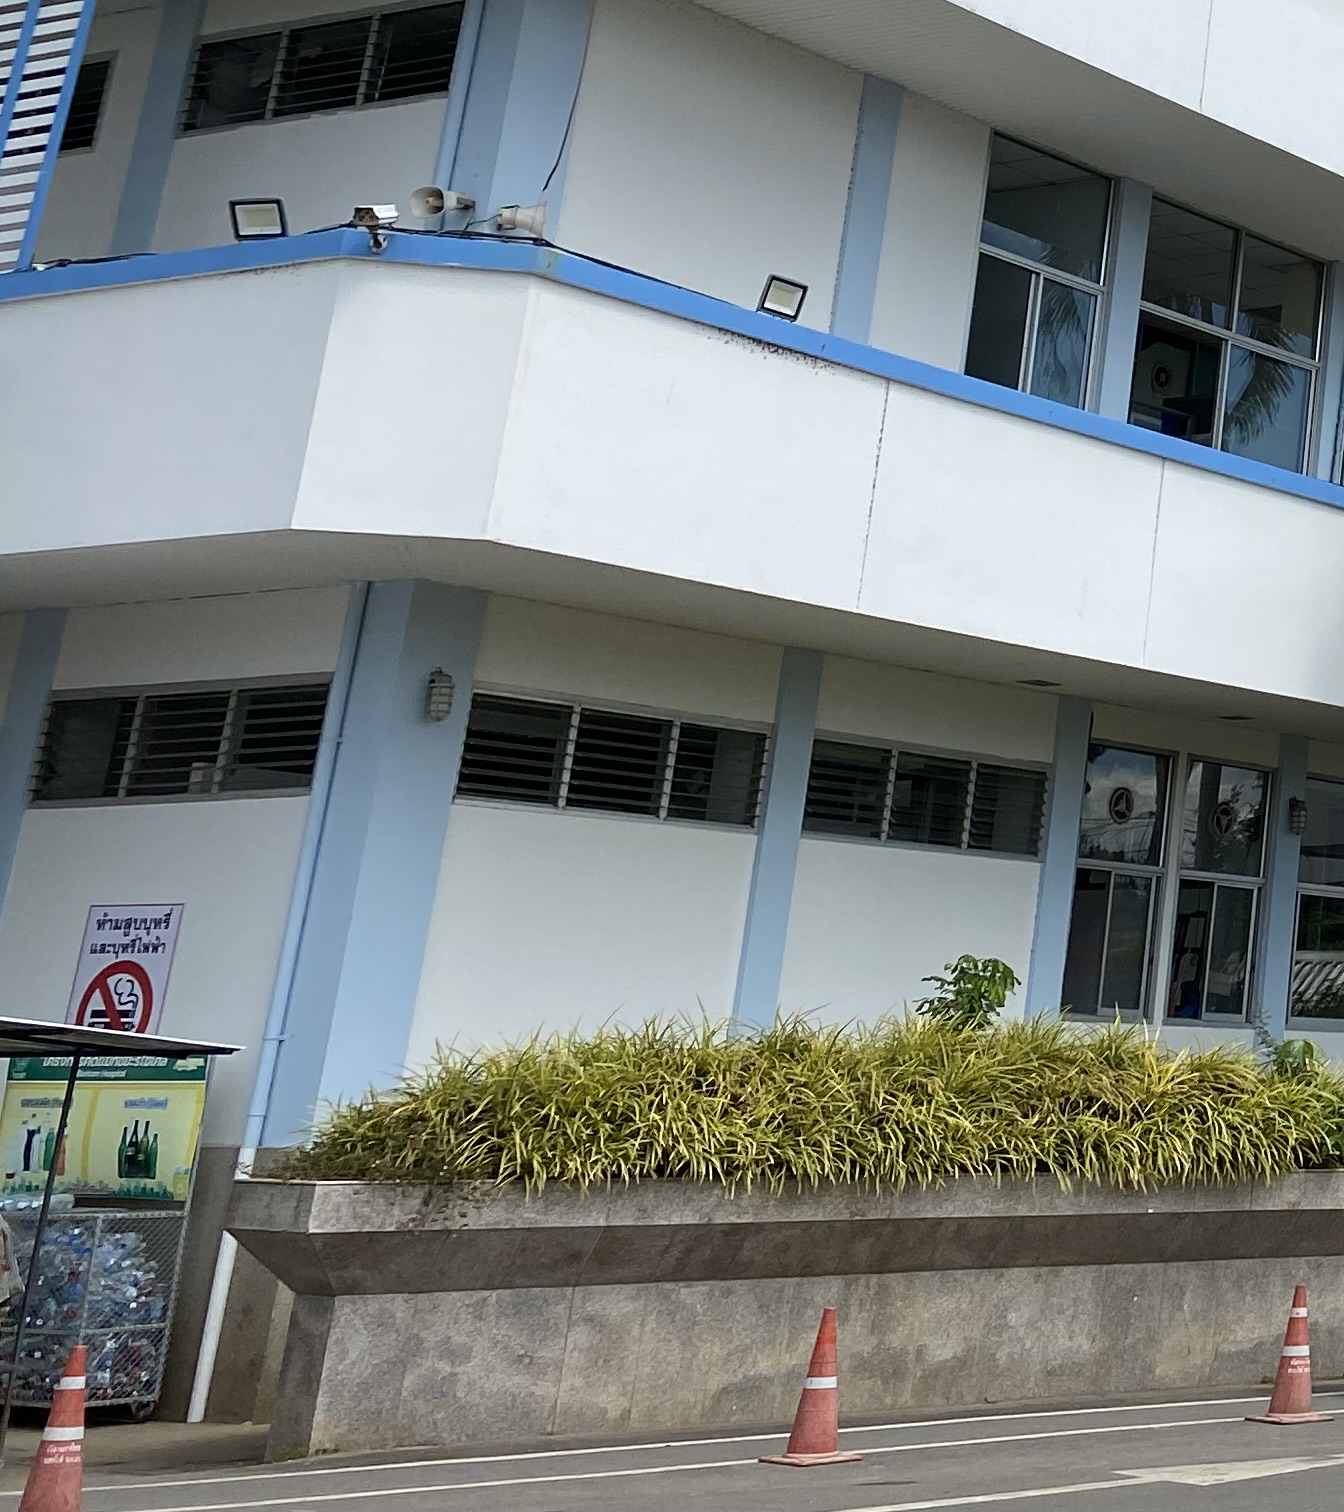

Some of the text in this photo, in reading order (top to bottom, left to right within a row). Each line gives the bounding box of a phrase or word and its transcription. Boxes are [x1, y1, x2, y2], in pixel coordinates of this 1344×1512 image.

[96, 907, 173, 937] ห้ามสูบบุหรี่
[89, 934, 166, 959] และบุหรี่ไฟฟ้า
